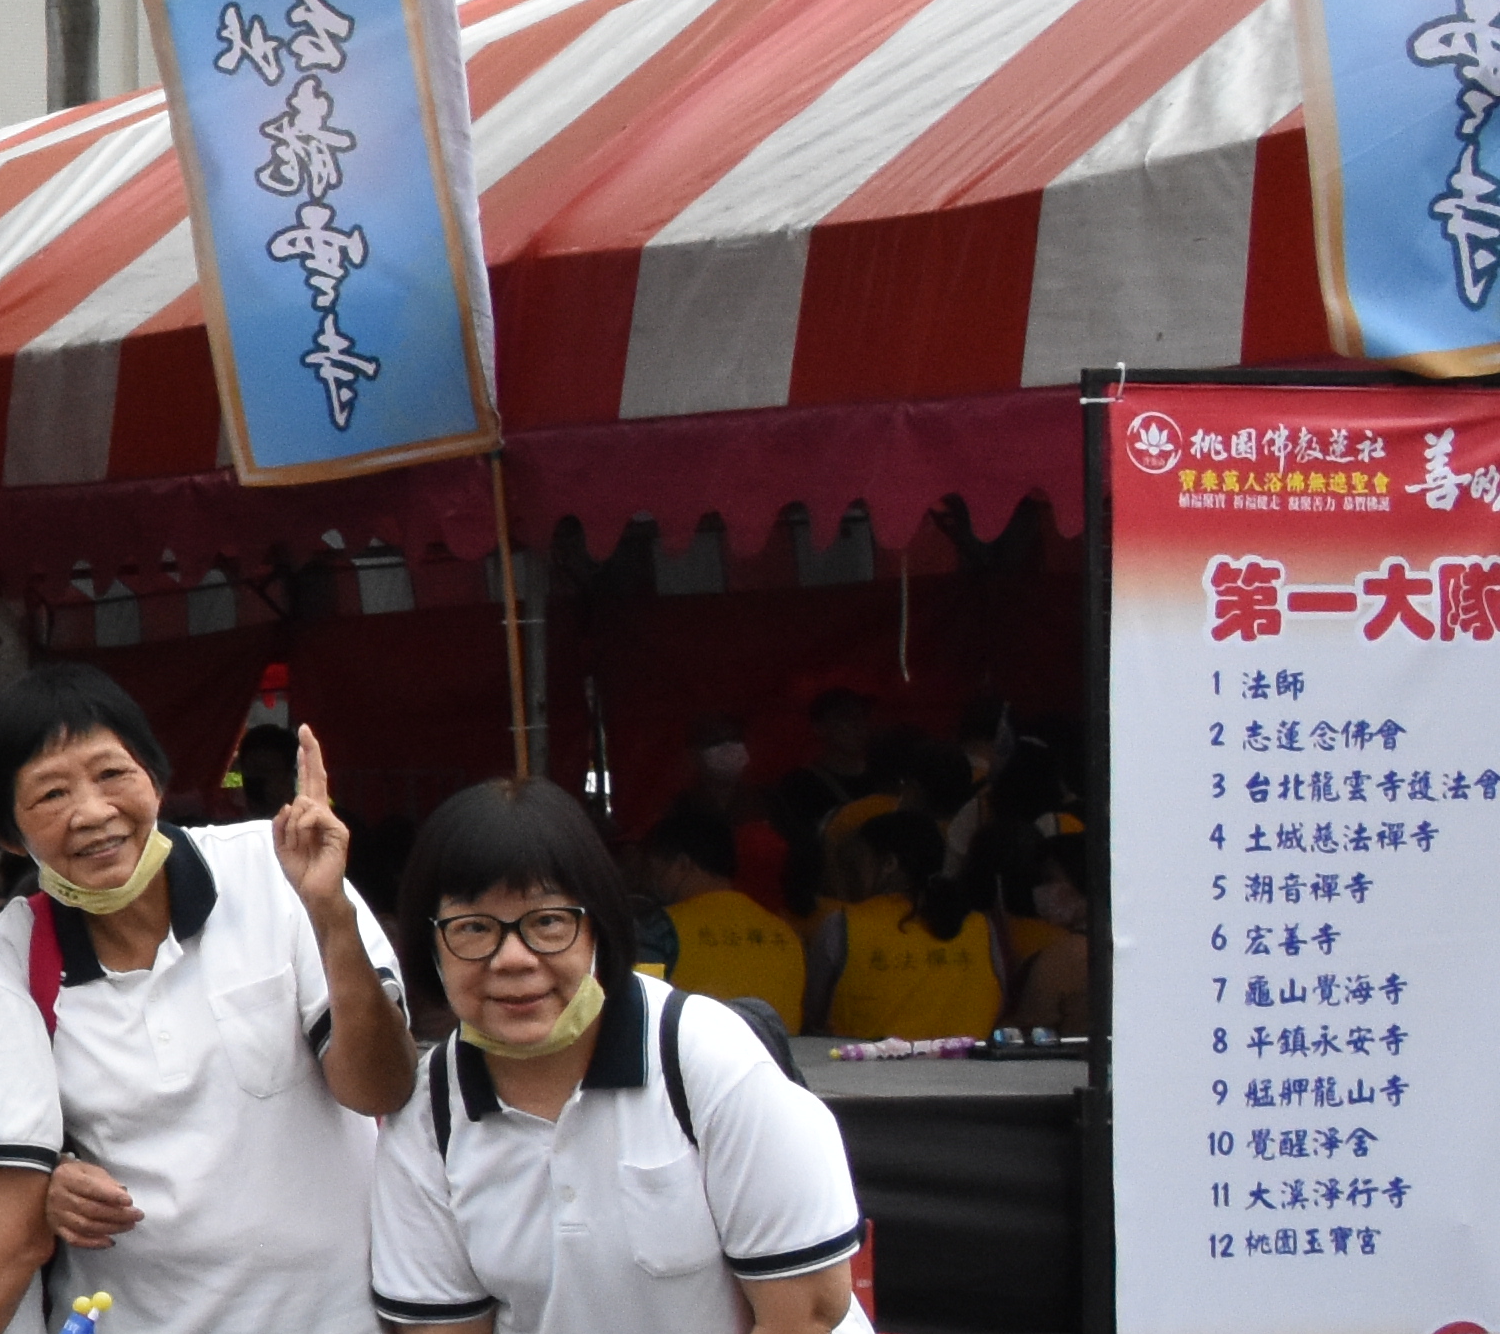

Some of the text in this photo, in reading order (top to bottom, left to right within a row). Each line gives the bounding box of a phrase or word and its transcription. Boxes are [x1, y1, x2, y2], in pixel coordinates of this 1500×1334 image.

[1211, 668, 1305, 701] 1 法師
[1208, 718, 1407, 752] 2 志蓮念佛會
[1211, 768, 1500, 803] 3 台北龍雲寺護法會
[1208, 820, 1440, 854] 4 土城慈法禪寺
[1211, 871, 1374, 904] 5 潮音禪寺
[1210, 922, 1342, 957] 6 宏善寺
[1211, 977, 1228, 1004] 7
[1212, 1023, 1409, 1059] 8 平鎮永安寺
[1211, 1079, 1229, 1106] 9
[1207, 1130, 1235, 1157] 10
[1210, 1175, 1412, 1211] 11 大溪淨行寺
[1208, 1232, 1235, 1259] 12
